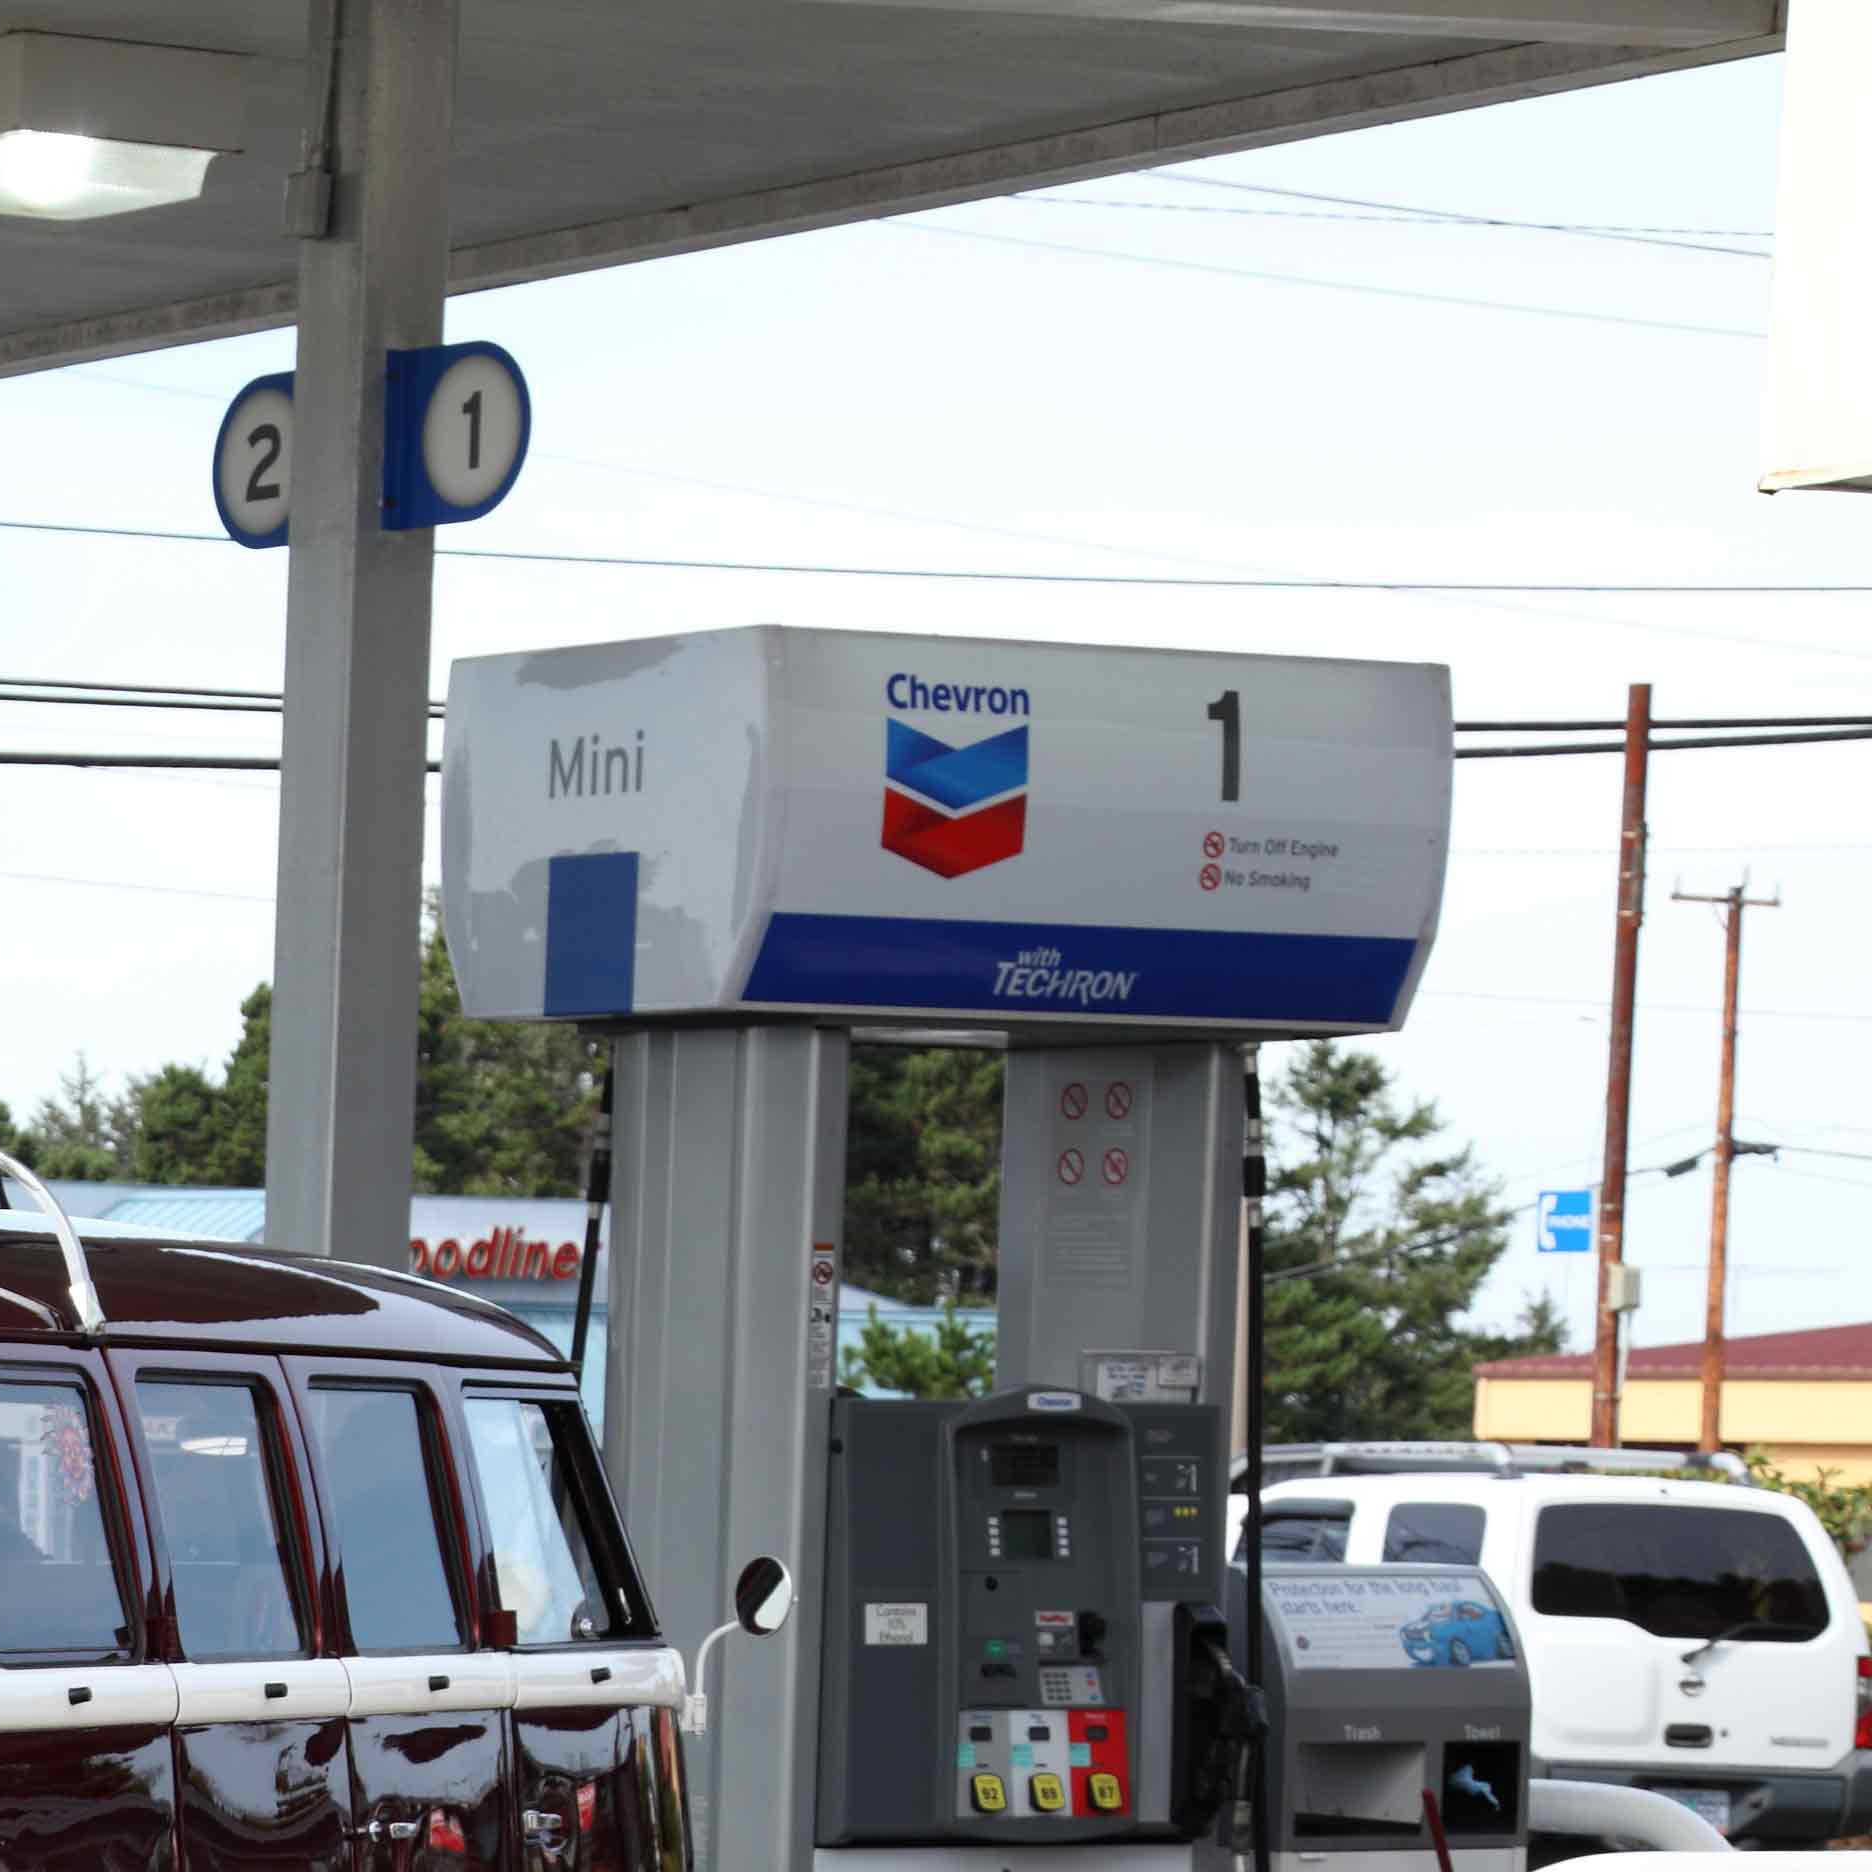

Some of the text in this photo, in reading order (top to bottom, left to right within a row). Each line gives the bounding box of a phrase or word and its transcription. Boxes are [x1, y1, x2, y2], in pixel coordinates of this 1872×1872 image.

[461, 389, 484, 470] 1
[245, 423, 282, 503] 2
[886, 673, 1030, 716] Chevron
[548, 730, 645, 799] Mini
[1206, 689, 1241, 803] 1
[1228, 836, 1339, 861] Turn Off Engine
[1224, 872, 1311, 894] No Smoking
[1016, 945, 1061, 968] with
[992, 962, 1137, 1006] TECHRON
